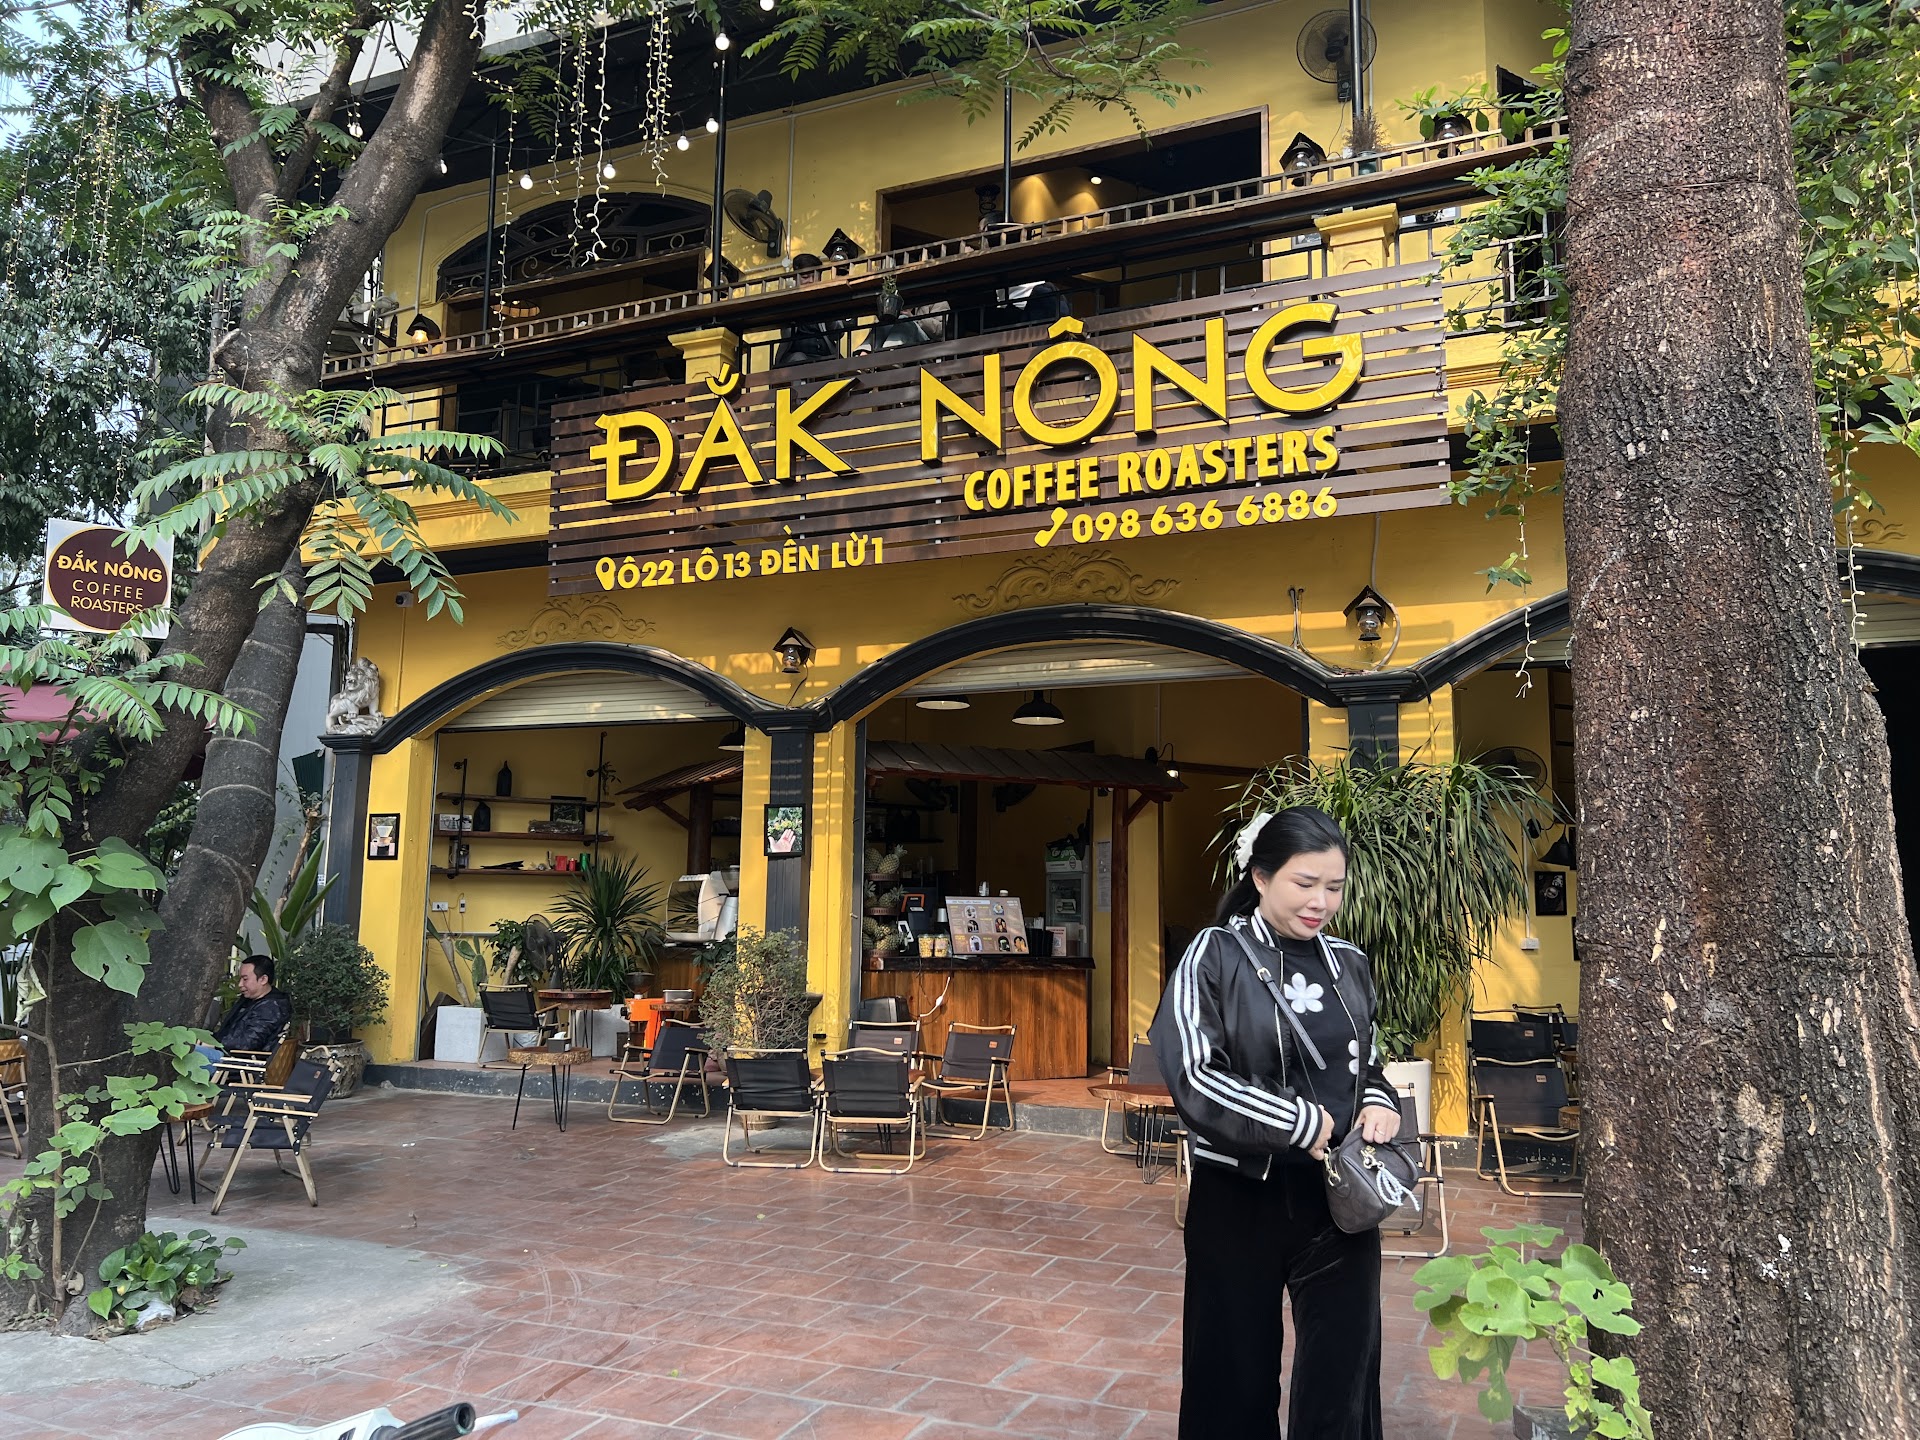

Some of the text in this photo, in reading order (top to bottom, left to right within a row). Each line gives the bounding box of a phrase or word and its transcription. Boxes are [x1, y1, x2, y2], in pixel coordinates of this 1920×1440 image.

[589, 302, 1364, 502] ĐẮK NÔNG
[964, 425, 1339, 511] COFFEE ROASTERS
[1071, 486, 1338, 543] 098 636 6886
[56, 549, 163, 583] ĐẮK NÔNG
[617, 556, 674, 589] Ô22
[759, 525, 819, 576] ĐỀN
[70, 595, 144, 615] ROASTERS
[72, 579, 144, 600] COFFEE
